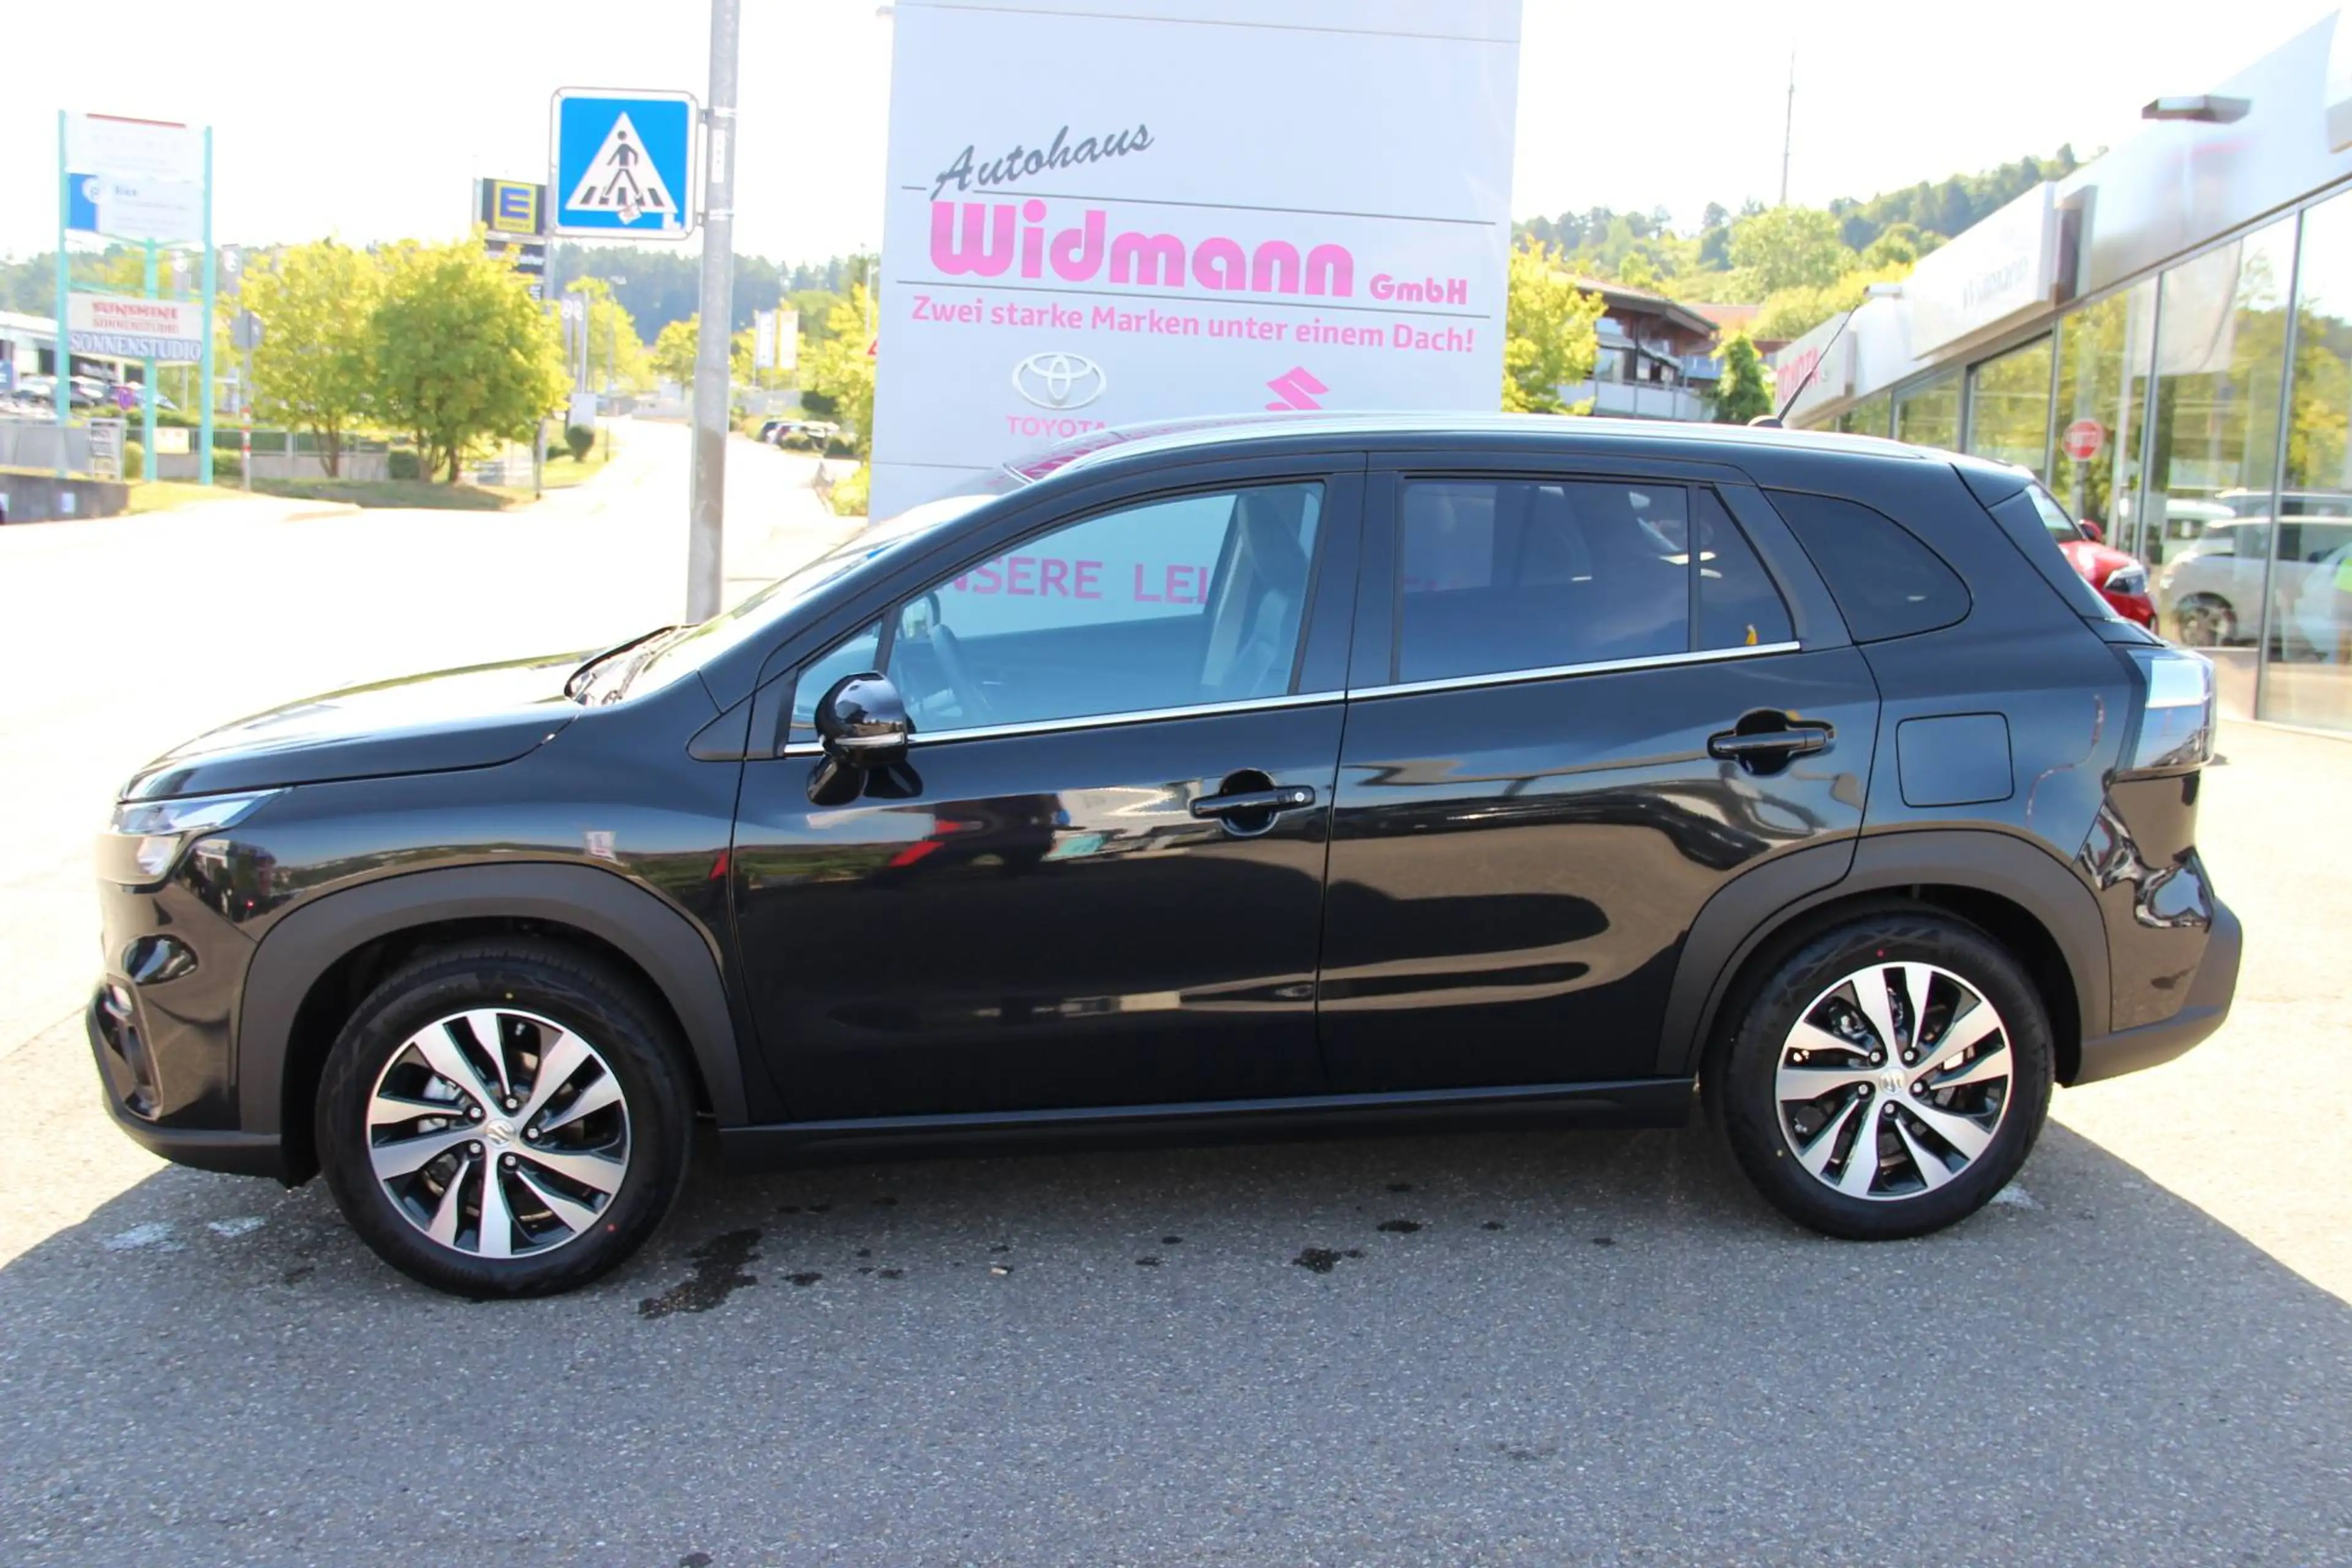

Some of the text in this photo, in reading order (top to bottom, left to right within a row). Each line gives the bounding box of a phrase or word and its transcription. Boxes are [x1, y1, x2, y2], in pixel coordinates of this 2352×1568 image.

[930, 124, 1155, 201] Autohaus
[500, 187, 531, 219] E
[930, 200, 1468, 305] Widmann GmbH
[70, 333, 202, 361] SONNENSTUDIO
[912, 295, 1474, 353] Zwei starke Marken unter einem Dach!
